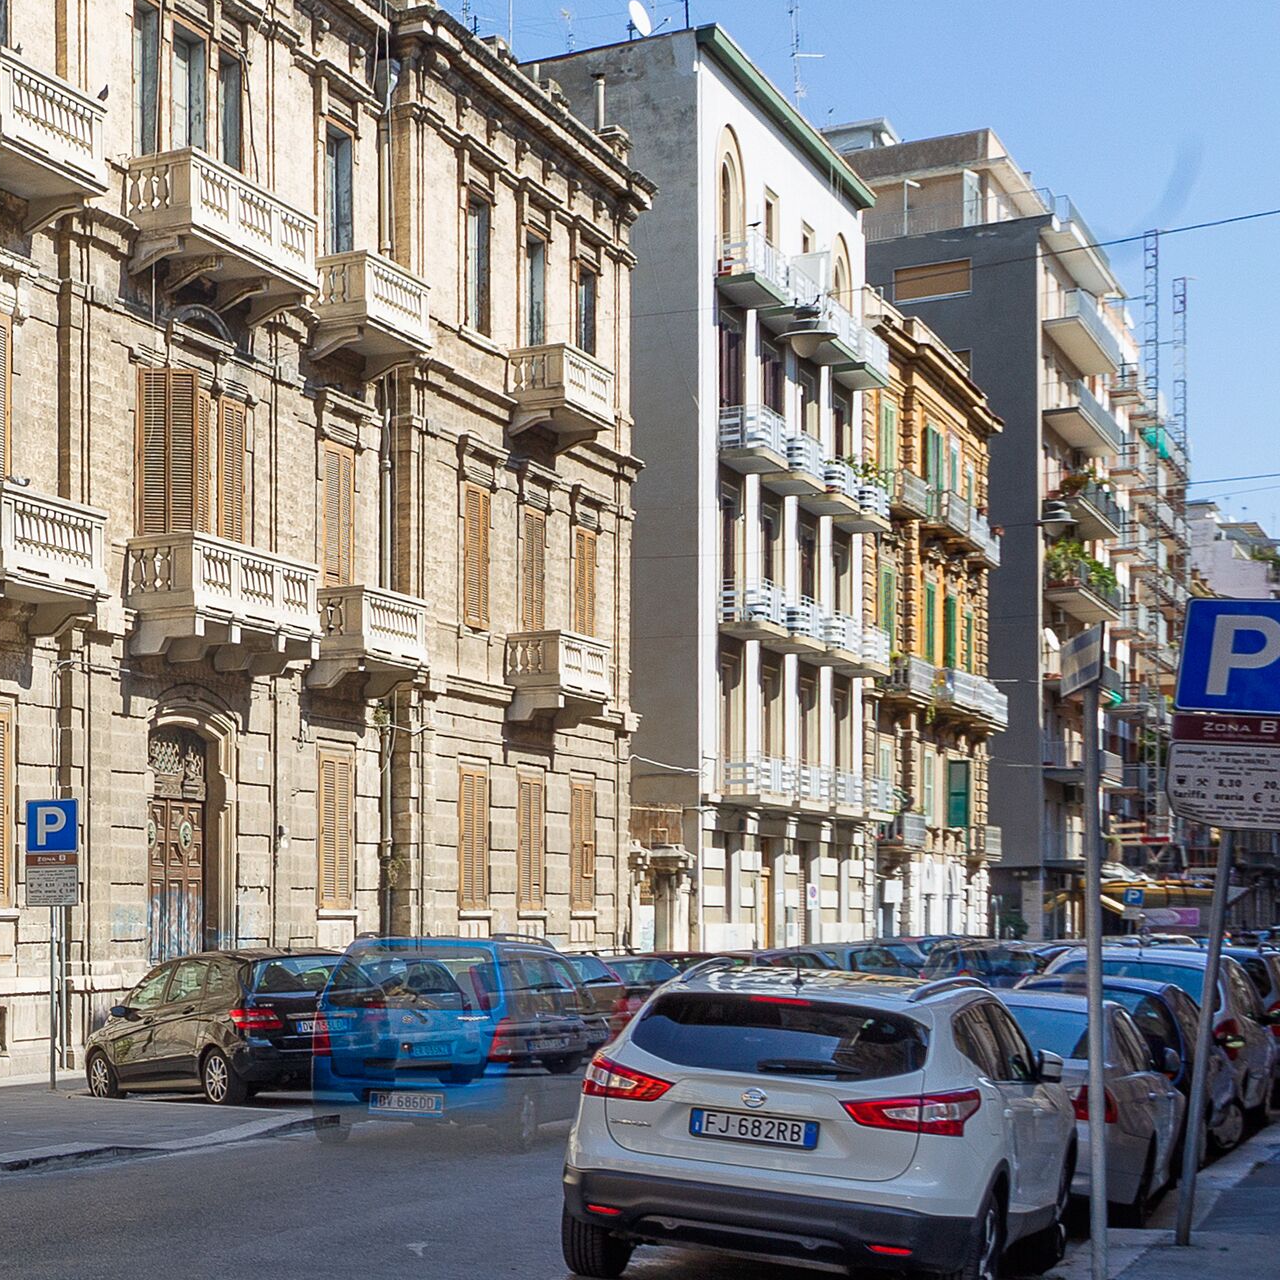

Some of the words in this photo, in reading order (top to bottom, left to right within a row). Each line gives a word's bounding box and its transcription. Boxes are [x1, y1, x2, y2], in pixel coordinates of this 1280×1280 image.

[1205, 614, 1280, 696] P
[1202, 721, 1251, 733] ZONA
[1261, 720, 1278, 733] B
[1173, 789, 1206, 800] tariffa
[37, 806, 67, 846] P
[397, 1096, 434, 1109] 686DD
[704, 1113, 731, 1134] FJ
[739, 1118, 802, 1142] 682RB
